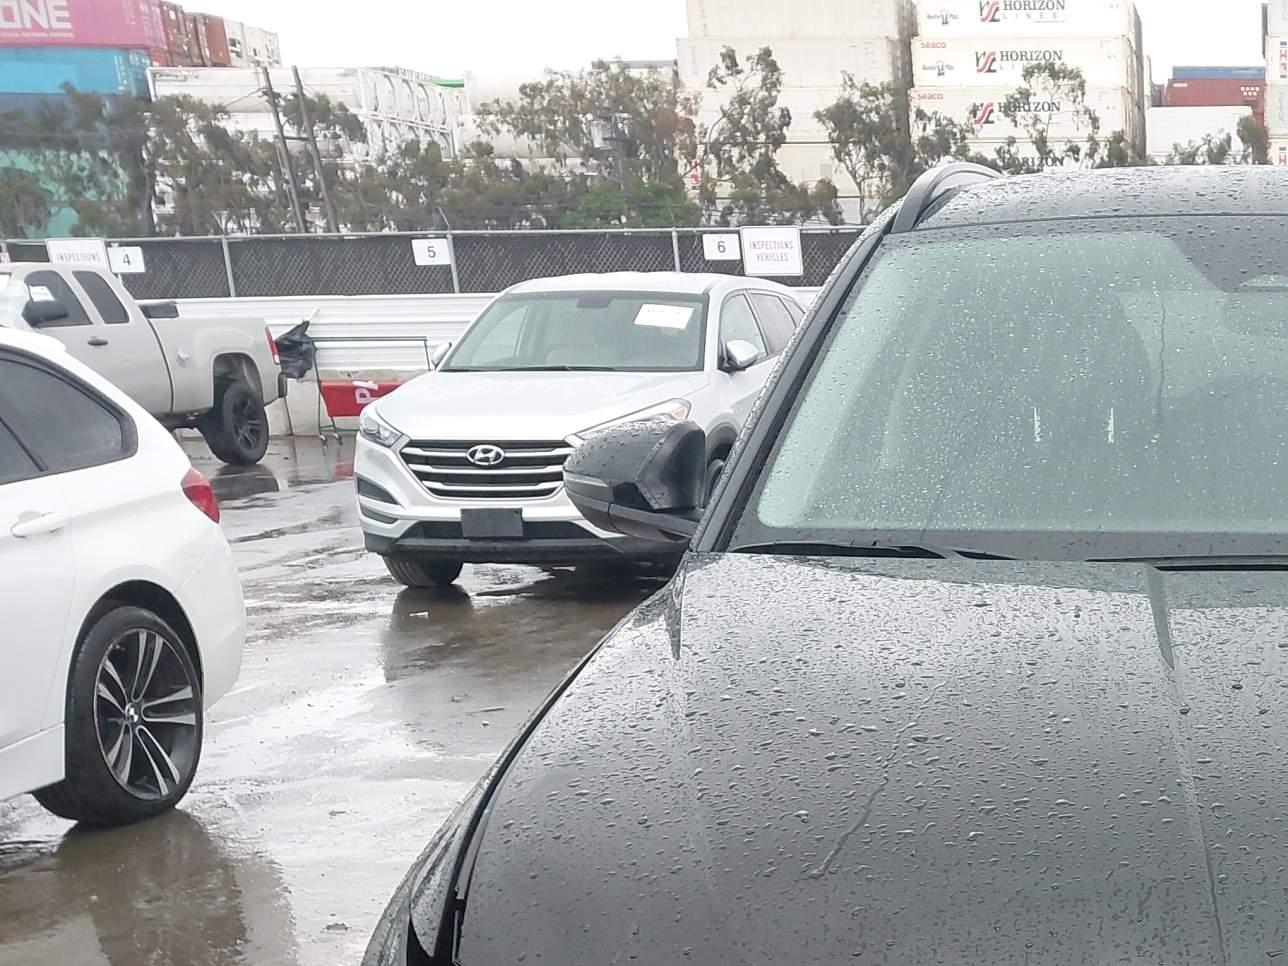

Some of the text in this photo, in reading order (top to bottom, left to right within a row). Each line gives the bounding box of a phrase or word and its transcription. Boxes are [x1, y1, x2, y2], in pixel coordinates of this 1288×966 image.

[1003, 0, 1065, 11] HORIZON
[999, 50, 1063, 62] HORIZON
[717, 240, 727, 254] 6
[749, 240, 795, 250] INSPECTIONS
[427, 245, 437, 258] 5
[756, 252, 789, 262] VEHICLES
[122, 253, 131, 267] 4
